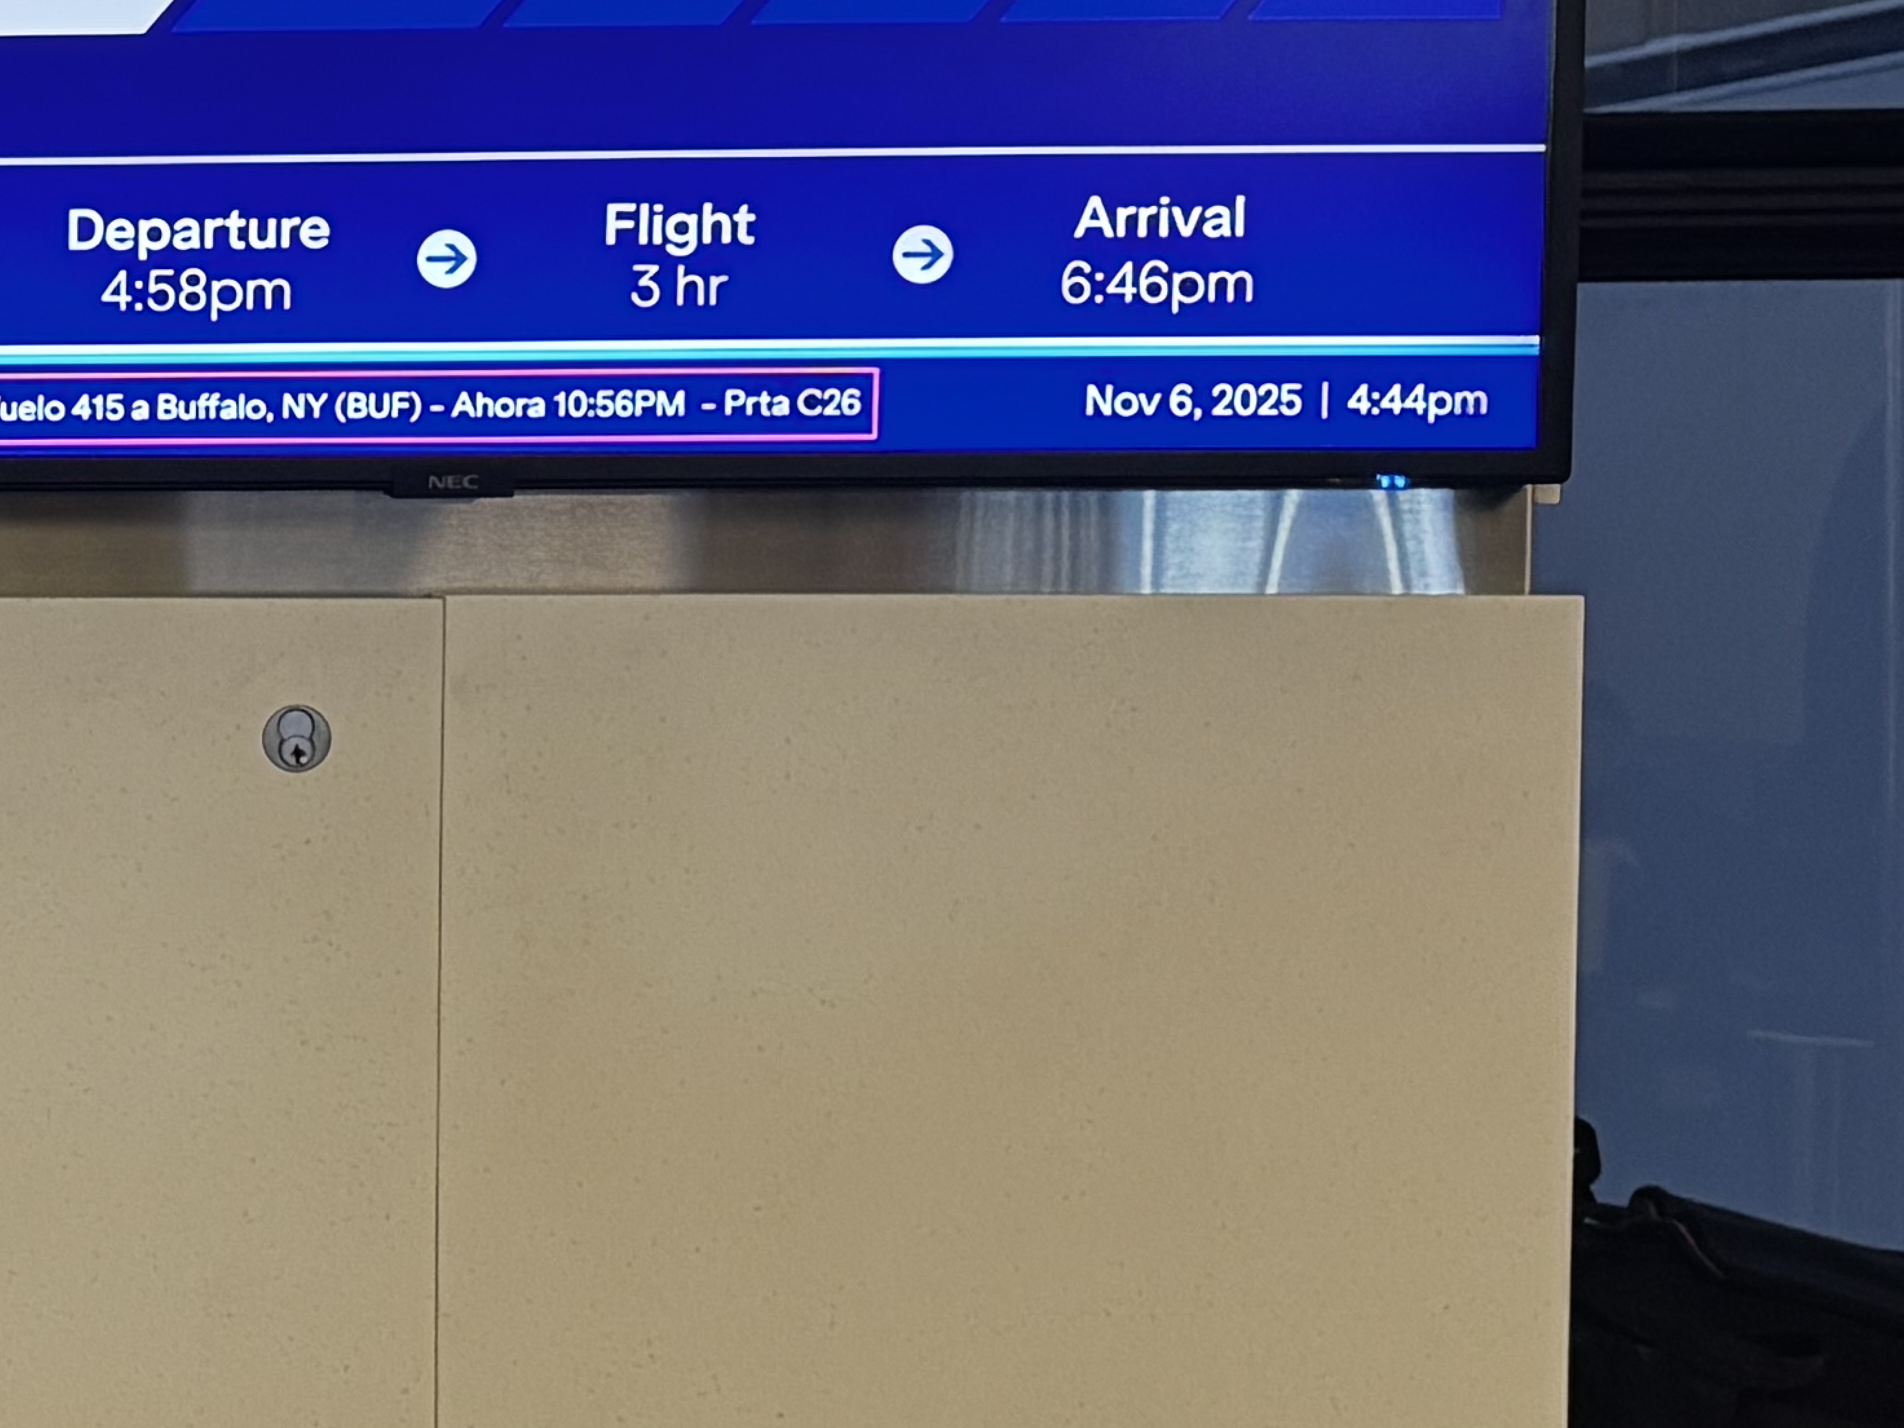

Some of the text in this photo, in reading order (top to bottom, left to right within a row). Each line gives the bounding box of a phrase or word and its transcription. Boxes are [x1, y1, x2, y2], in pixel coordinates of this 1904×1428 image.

[69, 209, 330, 257] Departure
[606, 202, 756, 256] Flight
[1074, 195, 1245, 238] Arrival
[101, 268, 290, 321] 4:58pm
[631, 265, 728, 307] 3 hr
[1062, 260, 1253, 314] 6:46pm
[71, 394, 124, 421] 415
[131, 400, 149, 420] a
[157, 393, 274, 423] Buffalo,
[283, 393, 328, 418] NY
[335, 391, 421, 423] (BUF)
[451, 391, 545, 418] Ahora
[554, 389, 685, 417] 10:56PM
[725, 389, 789, 416] Prta
[797, 388, 861, 416] C26
[1086, 384, 1161, 417] Nov
[1170, 383, 1202, 420] 6,
[1212, 383, 1302, 416] 2025
[1348, 384, 1487, 423] 4:44pm
[429, 475, 478, 489] NEC
